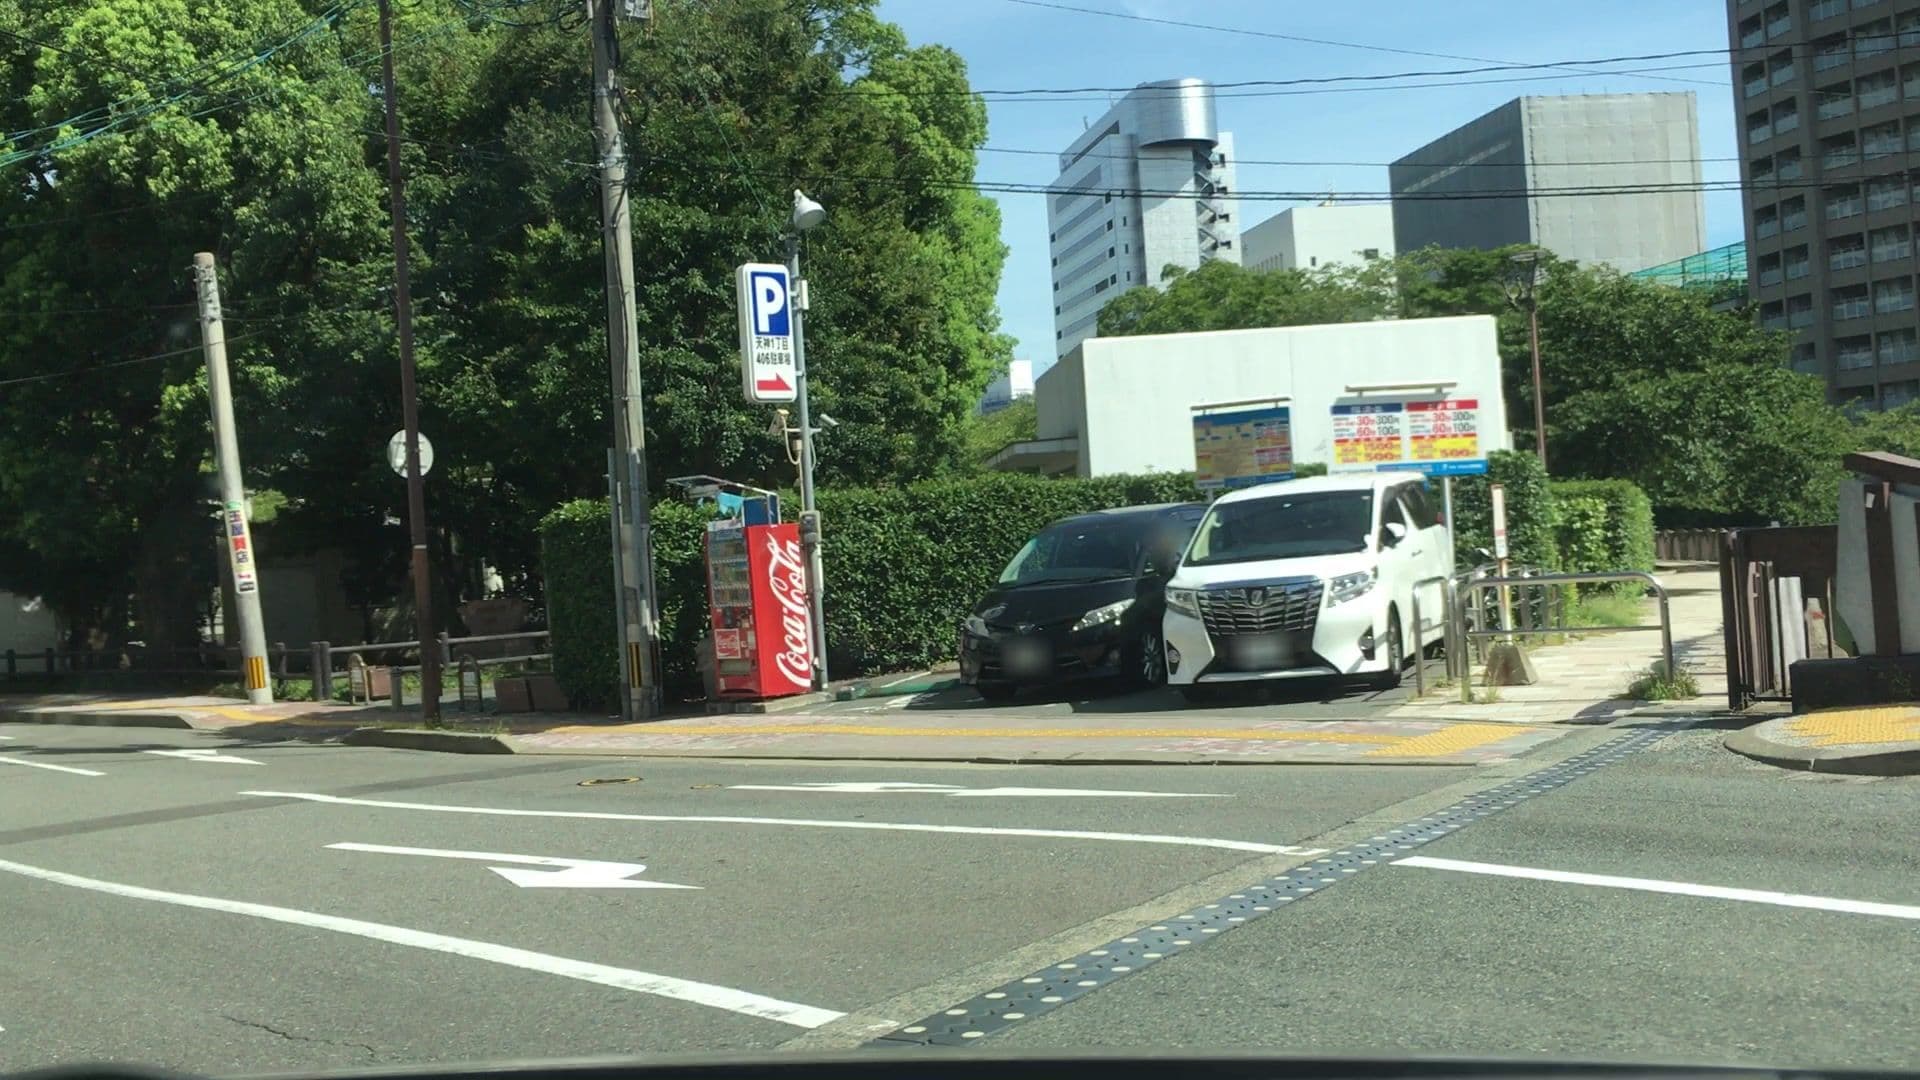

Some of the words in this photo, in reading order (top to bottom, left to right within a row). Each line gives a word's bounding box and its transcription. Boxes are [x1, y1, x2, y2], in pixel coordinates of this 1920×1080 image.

[755, 276, 785, 332] P
[755, 337, 788, 350] 天神1丁目
[767, 531, 812, 688] Coca-Cola
